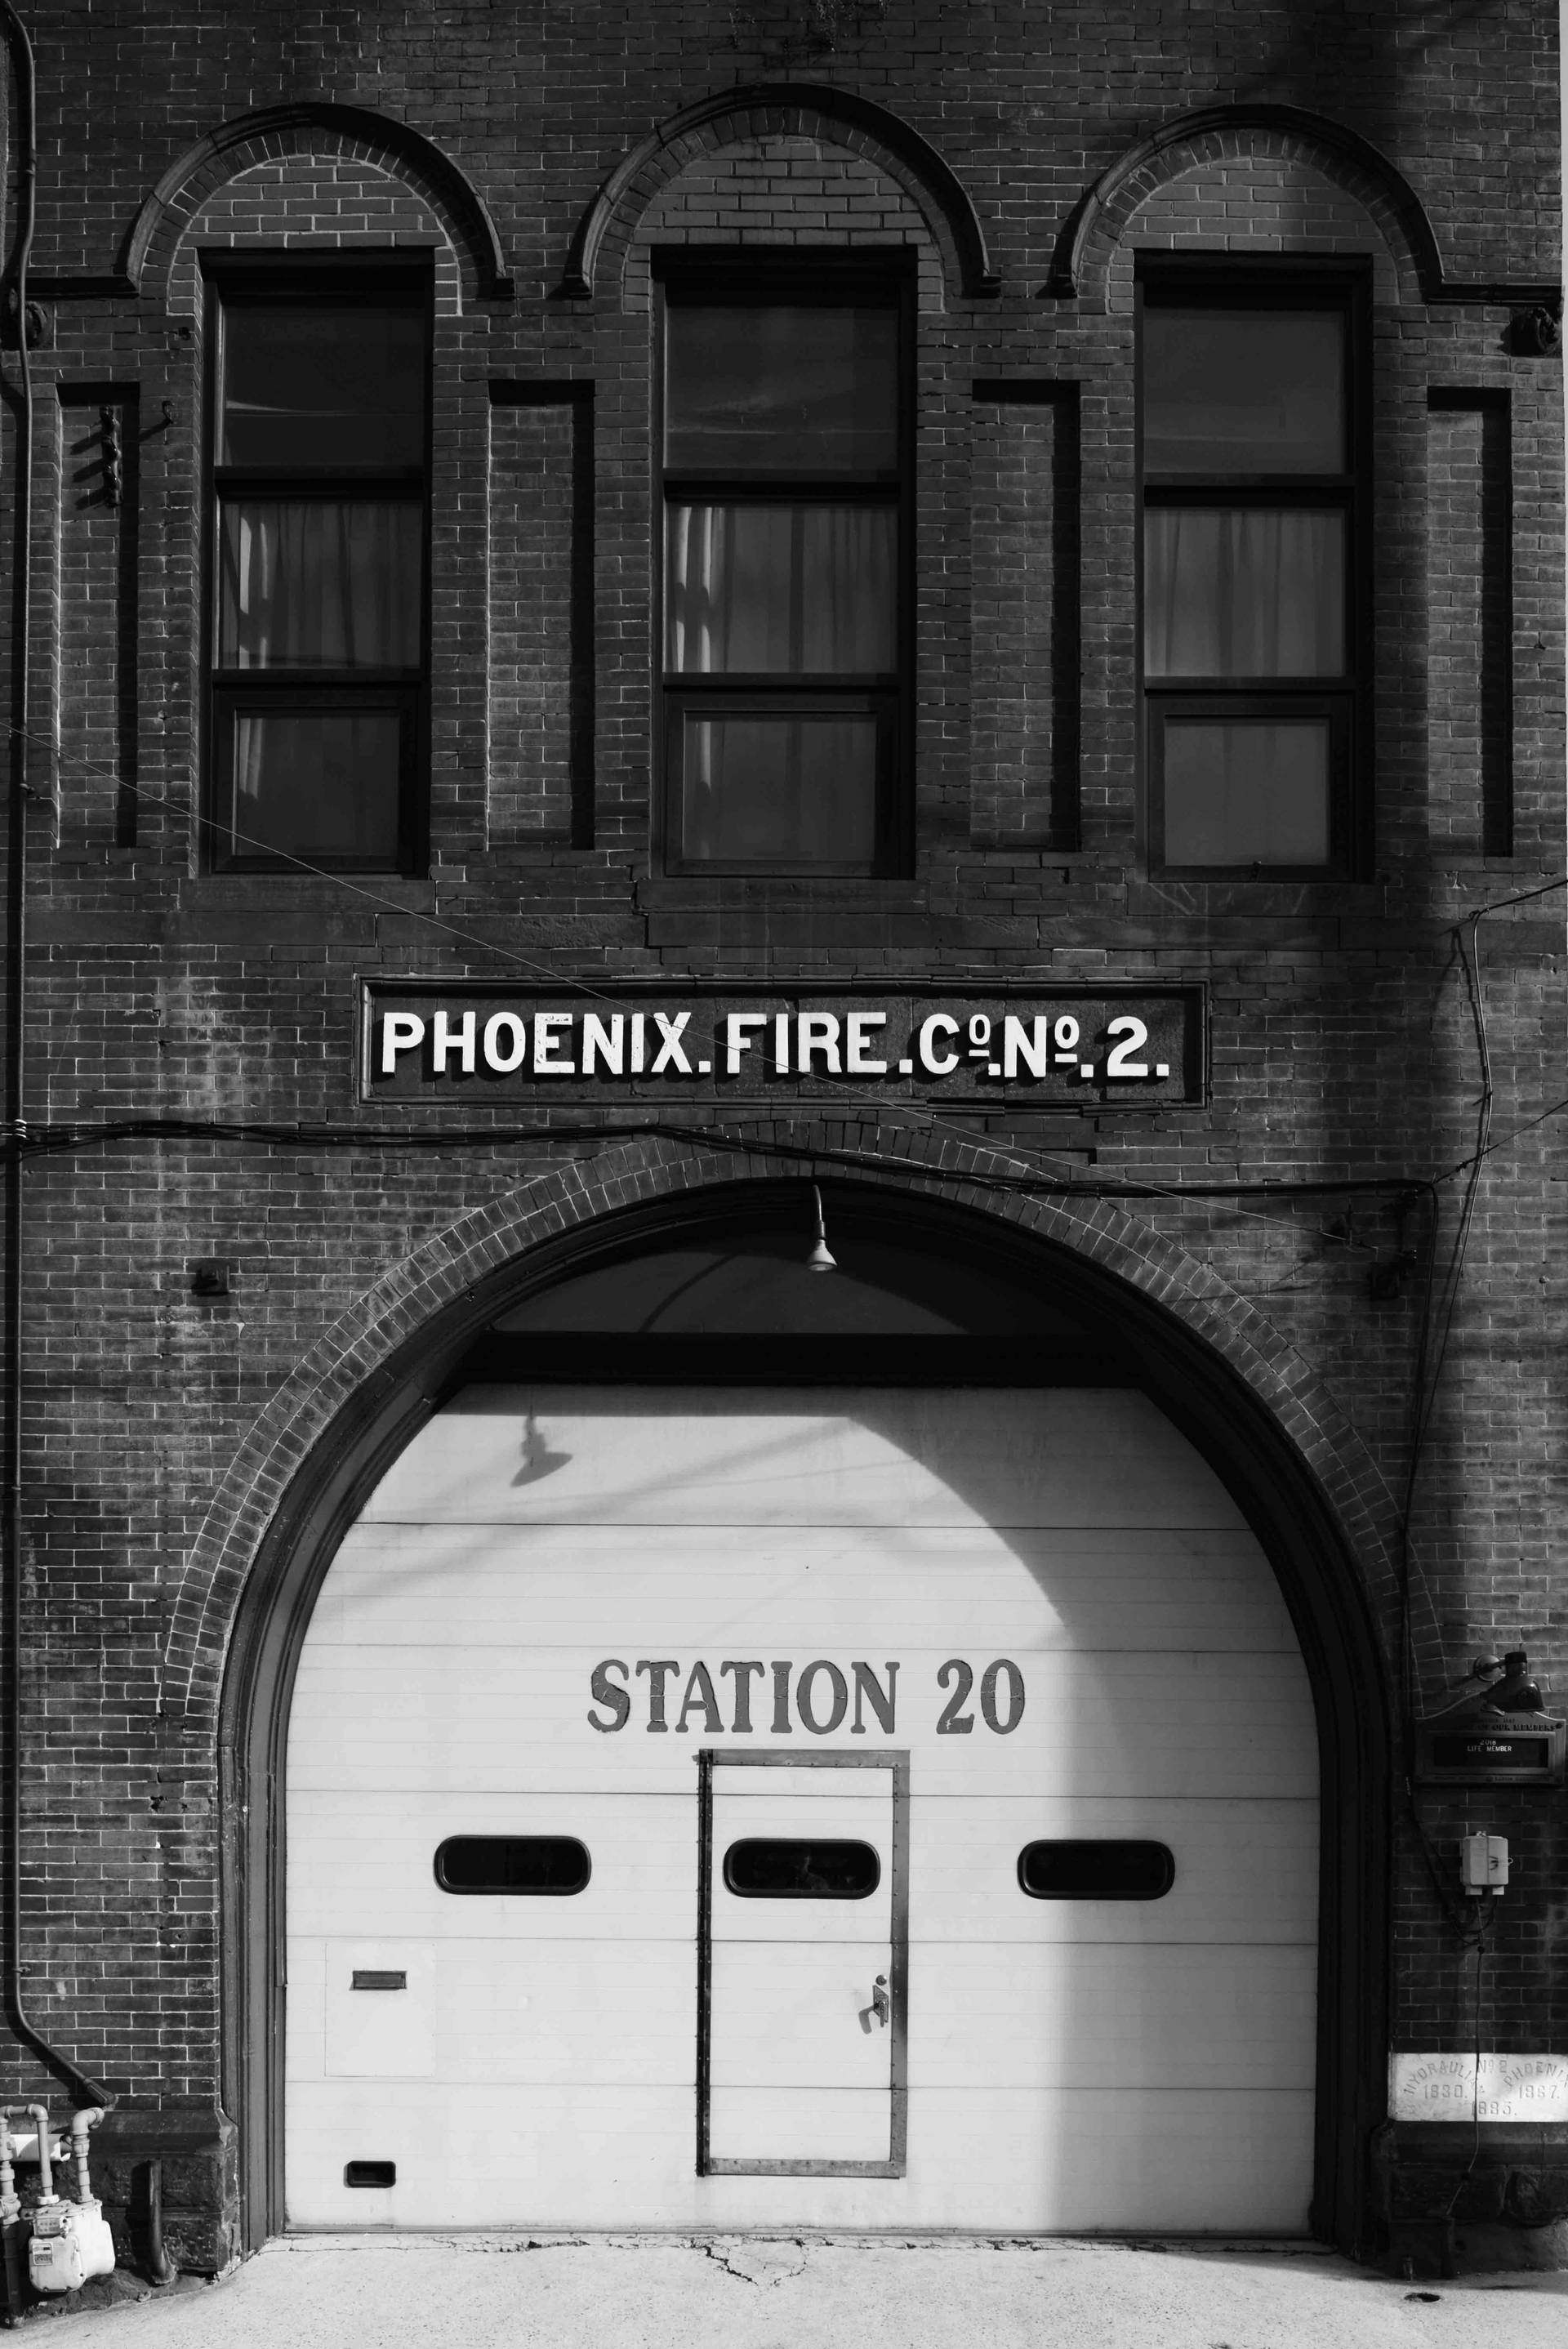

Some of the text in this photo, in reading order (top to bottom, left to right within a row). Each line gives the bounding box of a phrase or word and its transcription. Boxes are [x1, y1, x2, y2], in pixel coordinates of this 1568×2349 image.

[587, 1659, 1026, 1735] STATION 20
[1499, 2059, 1508, 2074] 2
